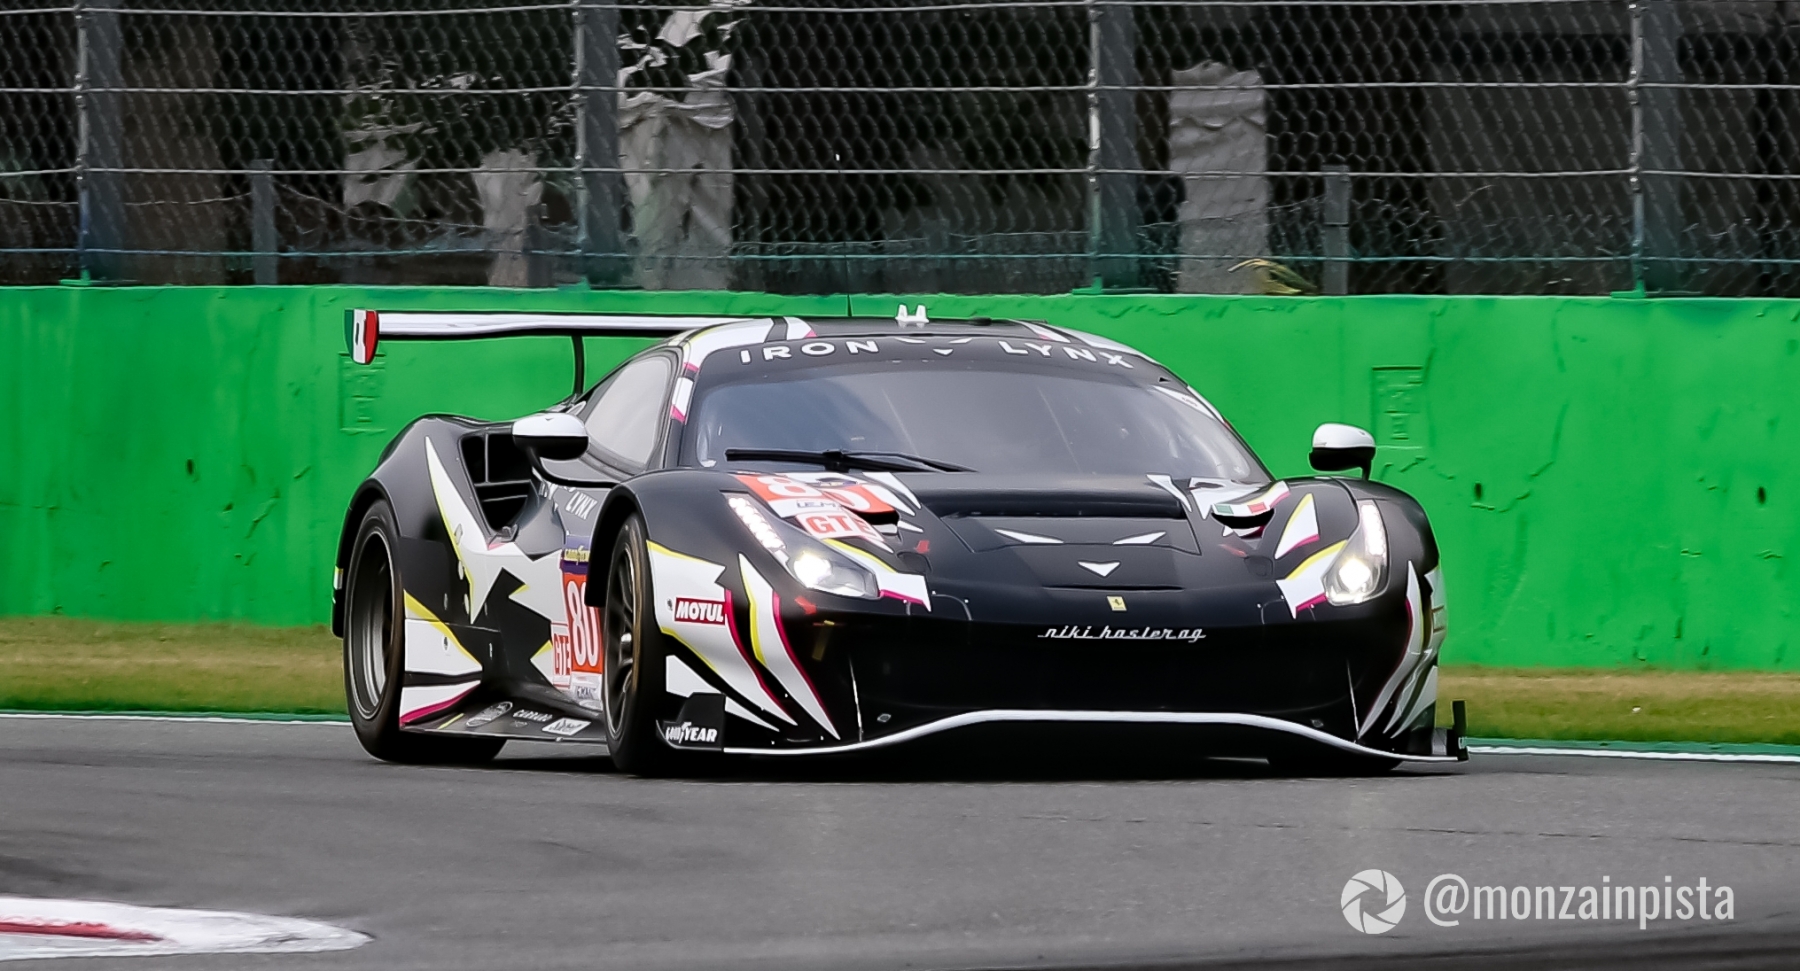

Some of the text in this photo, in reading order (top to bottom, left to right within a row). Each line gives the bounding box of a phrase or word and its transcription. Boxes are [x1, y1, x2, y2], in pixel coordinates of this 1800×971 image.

[740, 340, 1134, 369] IRON LYNX
[565, 491, 598, 520] LYNX
[806, 515, 876, 538] GTE
[567, 581, 599, 667] 80
[676, 601, 724, 622] MOTUL
[1040, 625, 1095, 639] niki
[554, 633, 571, 676] GTE
